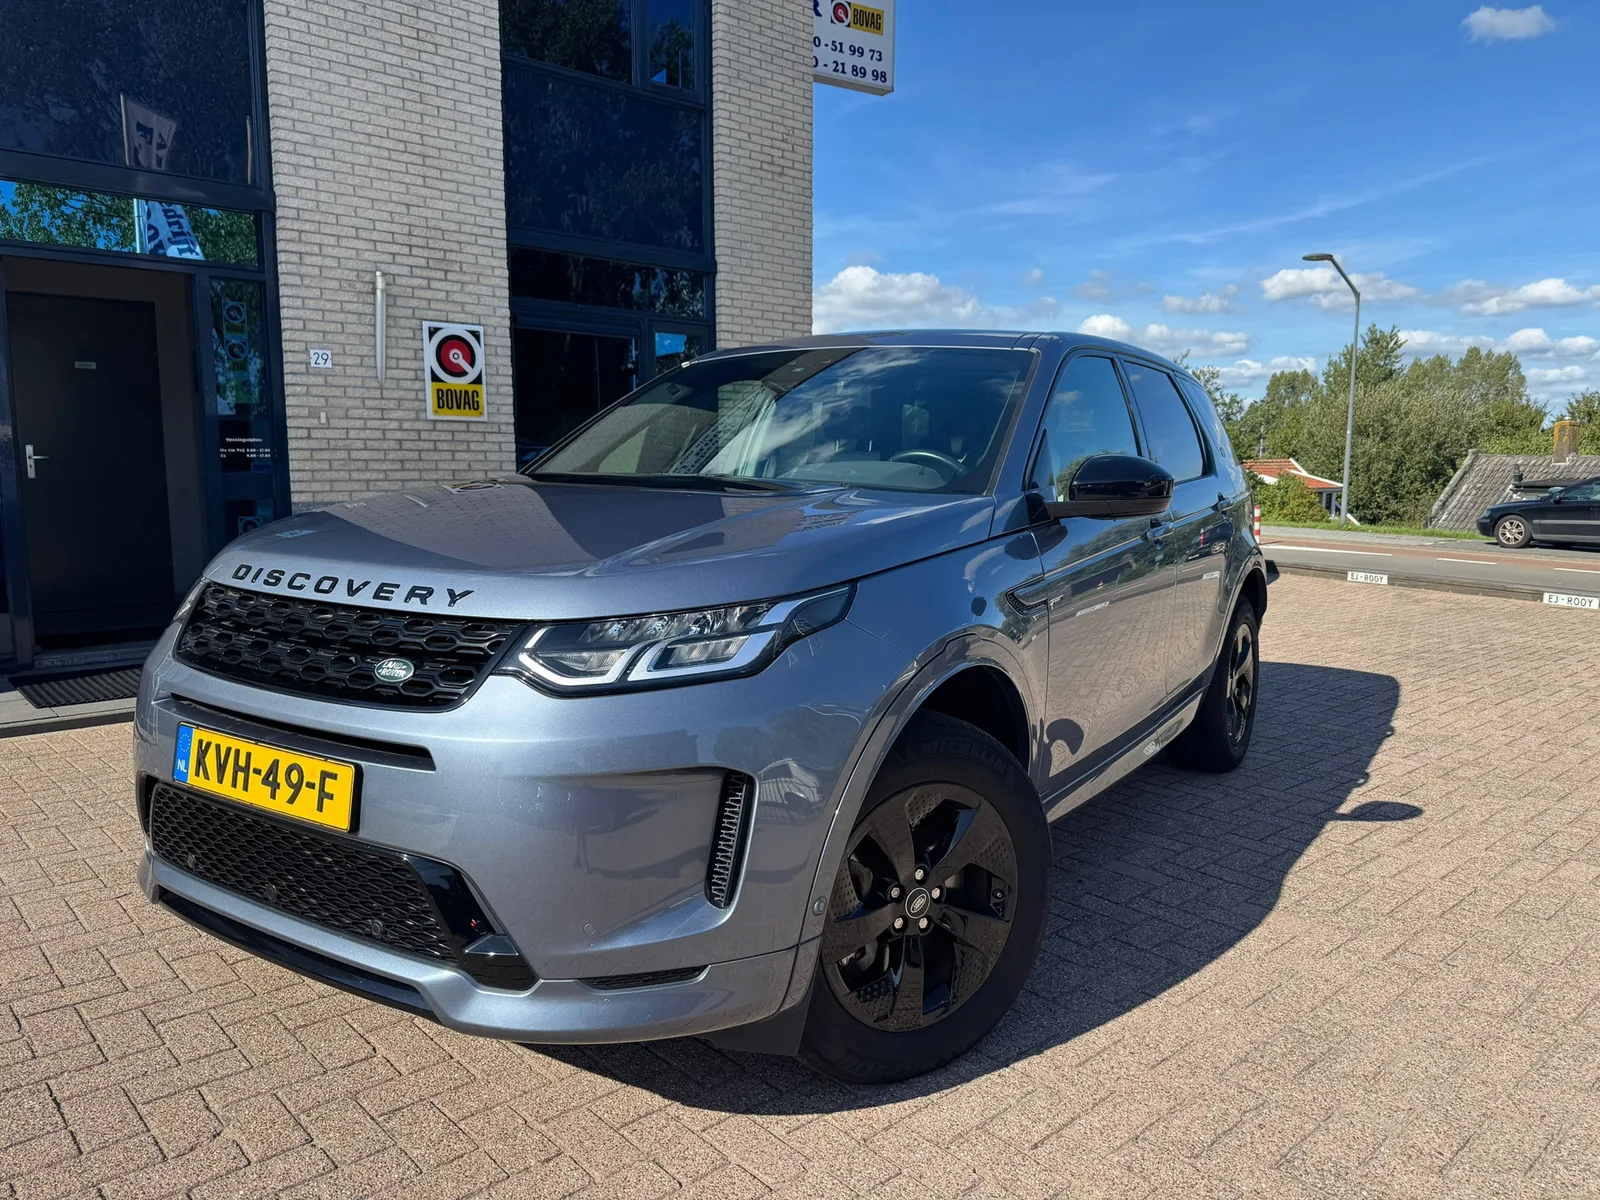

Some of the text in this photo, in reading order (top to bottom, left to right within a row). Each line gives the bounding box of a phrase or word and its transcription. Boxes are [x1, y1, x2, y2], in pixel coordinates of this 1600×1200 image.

[852, 8, 882, 31] BOVAG
[849, 44, 865, 58] 99
[869, 49, 883, 62] 73
[851, 65, 867, 79] 89
[871, 69, 888, 83] 98
[313, 352, 330, 366] 29
[436, 388, 480, 411] BOVAG
[232, 563, 474, 608] DISCOVERY
[380, 669, 406, 678] ROVER
[382, 661, 403, 669] LAND
[177, 758, 188, 773] NL
[194, 738, 339, 814] KVH-49-F
